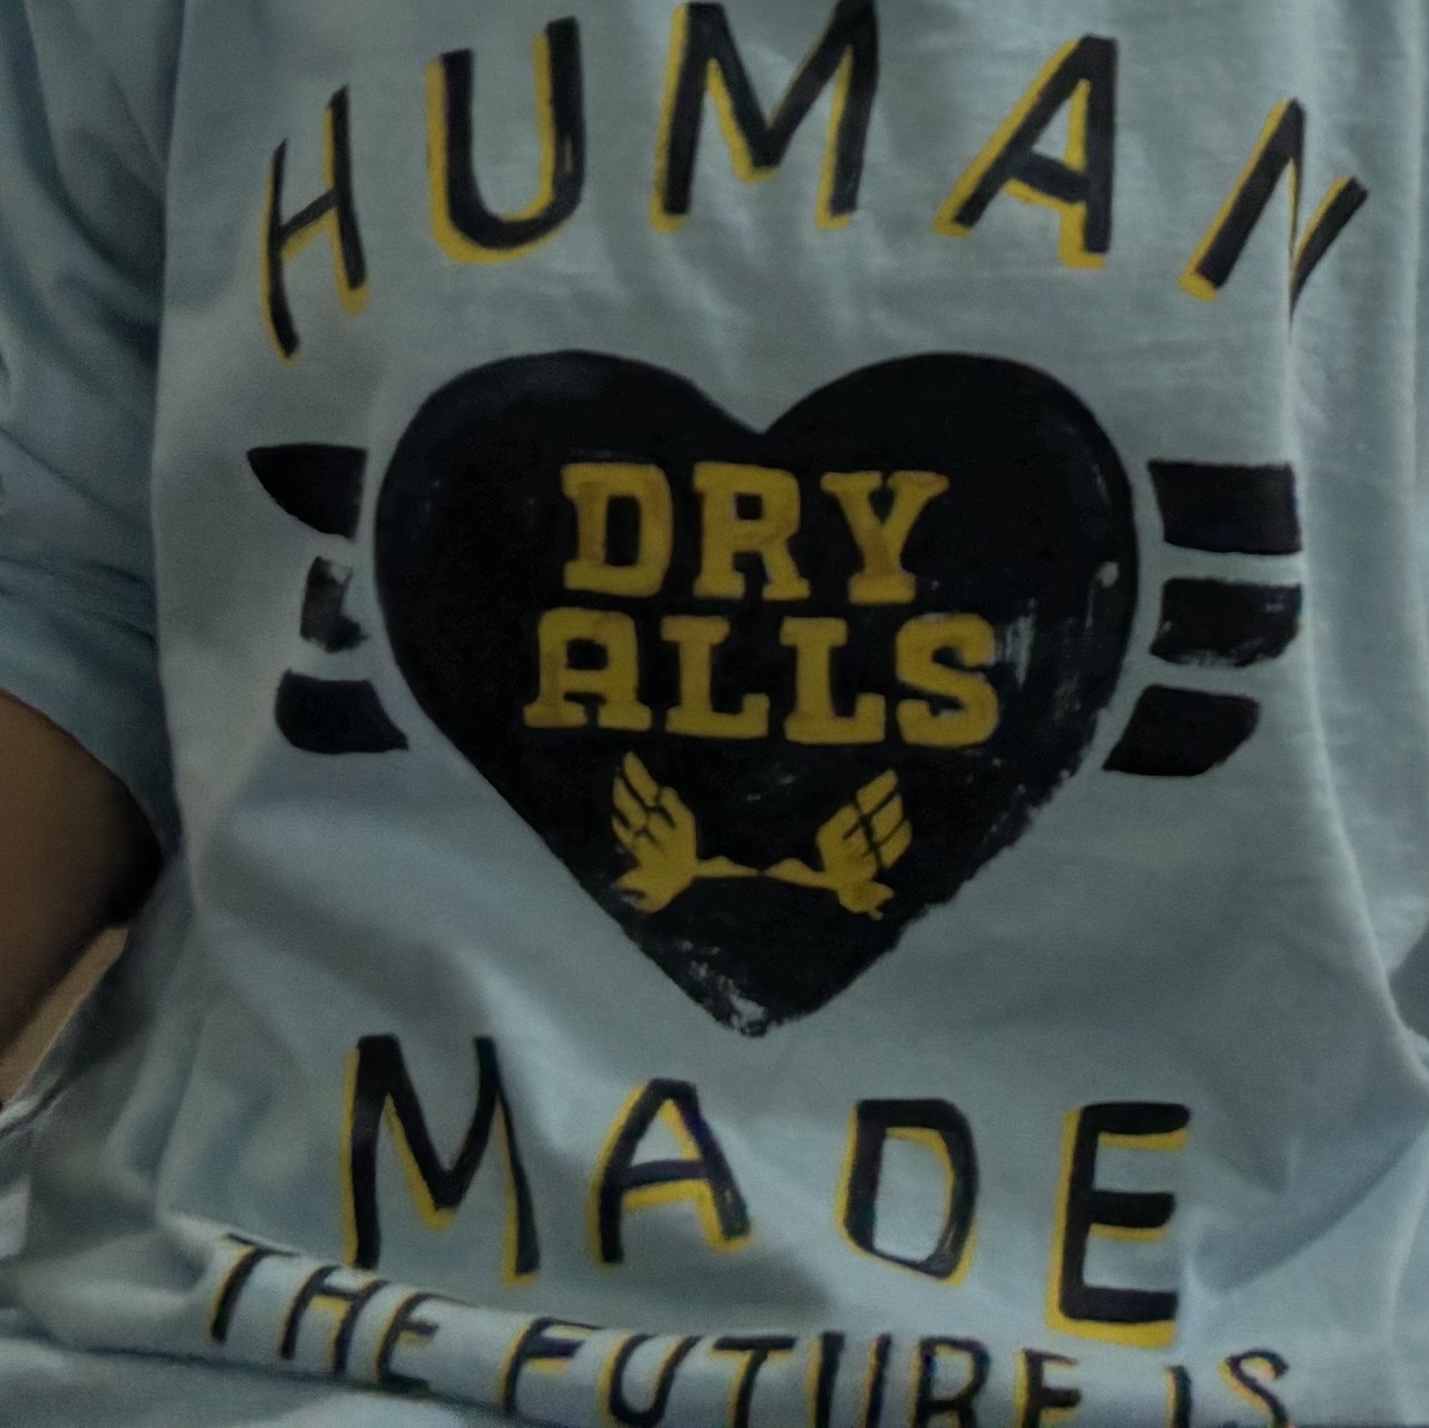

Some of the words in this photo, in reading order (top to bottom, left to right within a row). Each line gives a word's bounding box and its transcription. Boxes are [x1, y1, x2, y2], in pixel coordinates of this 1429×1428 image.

[560, 460, 951, 606] DRY
[522, 605, 1000, 748] ALLS
[343, 1033, 1191, 1346] MADE
[208, 1232, 472, 1396] THE
